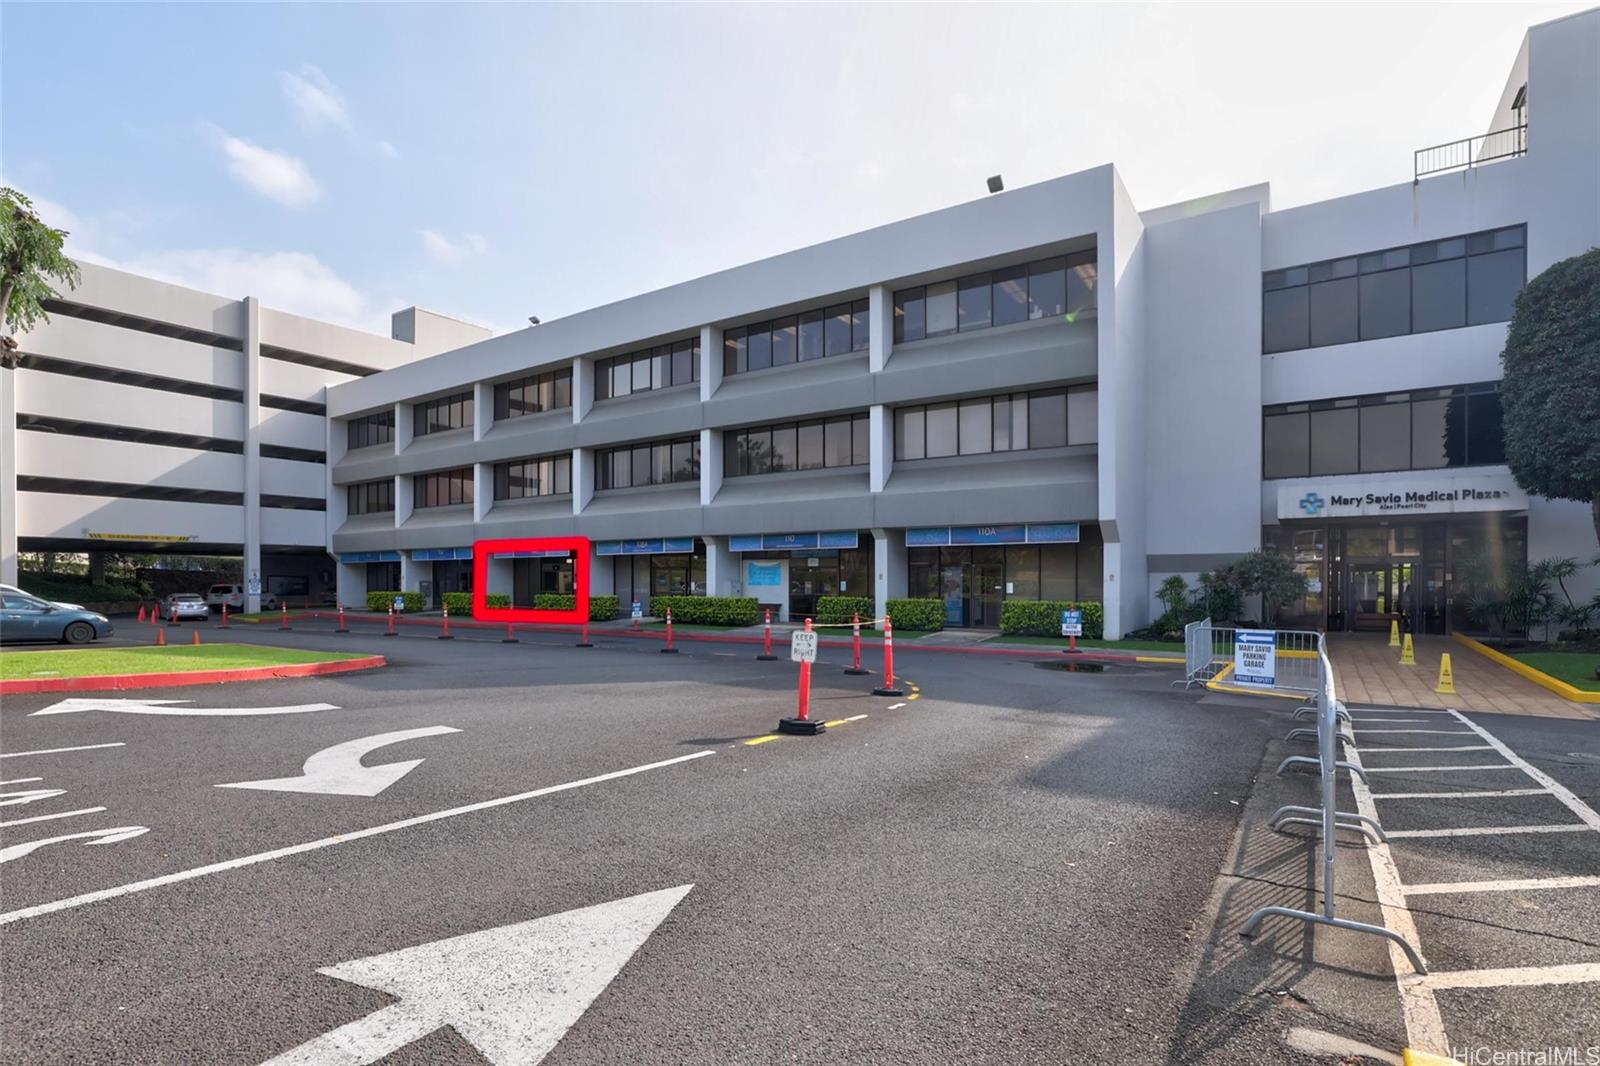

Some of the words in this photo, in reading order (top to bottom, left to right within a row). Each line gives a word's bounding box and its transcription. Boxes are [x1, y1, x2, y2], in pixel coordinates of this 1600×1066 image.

[1330, 495, 1363, 508] Mary
[1365, 492, 1402, 505] Savio
[1405, 489, 1459, 503] Medical
[1461, 488, 1501, 500] Plaza
[978, 527, 997, 537] 110A
[795, 633, 815, 641] KEEP
[793, 647, 814, 656] RIGHT
[1238, 644, 1254, 652] MARY
[1242, 652, 1267, 661] PARKING
[1243, 660, 1265, 669] GARAGE
